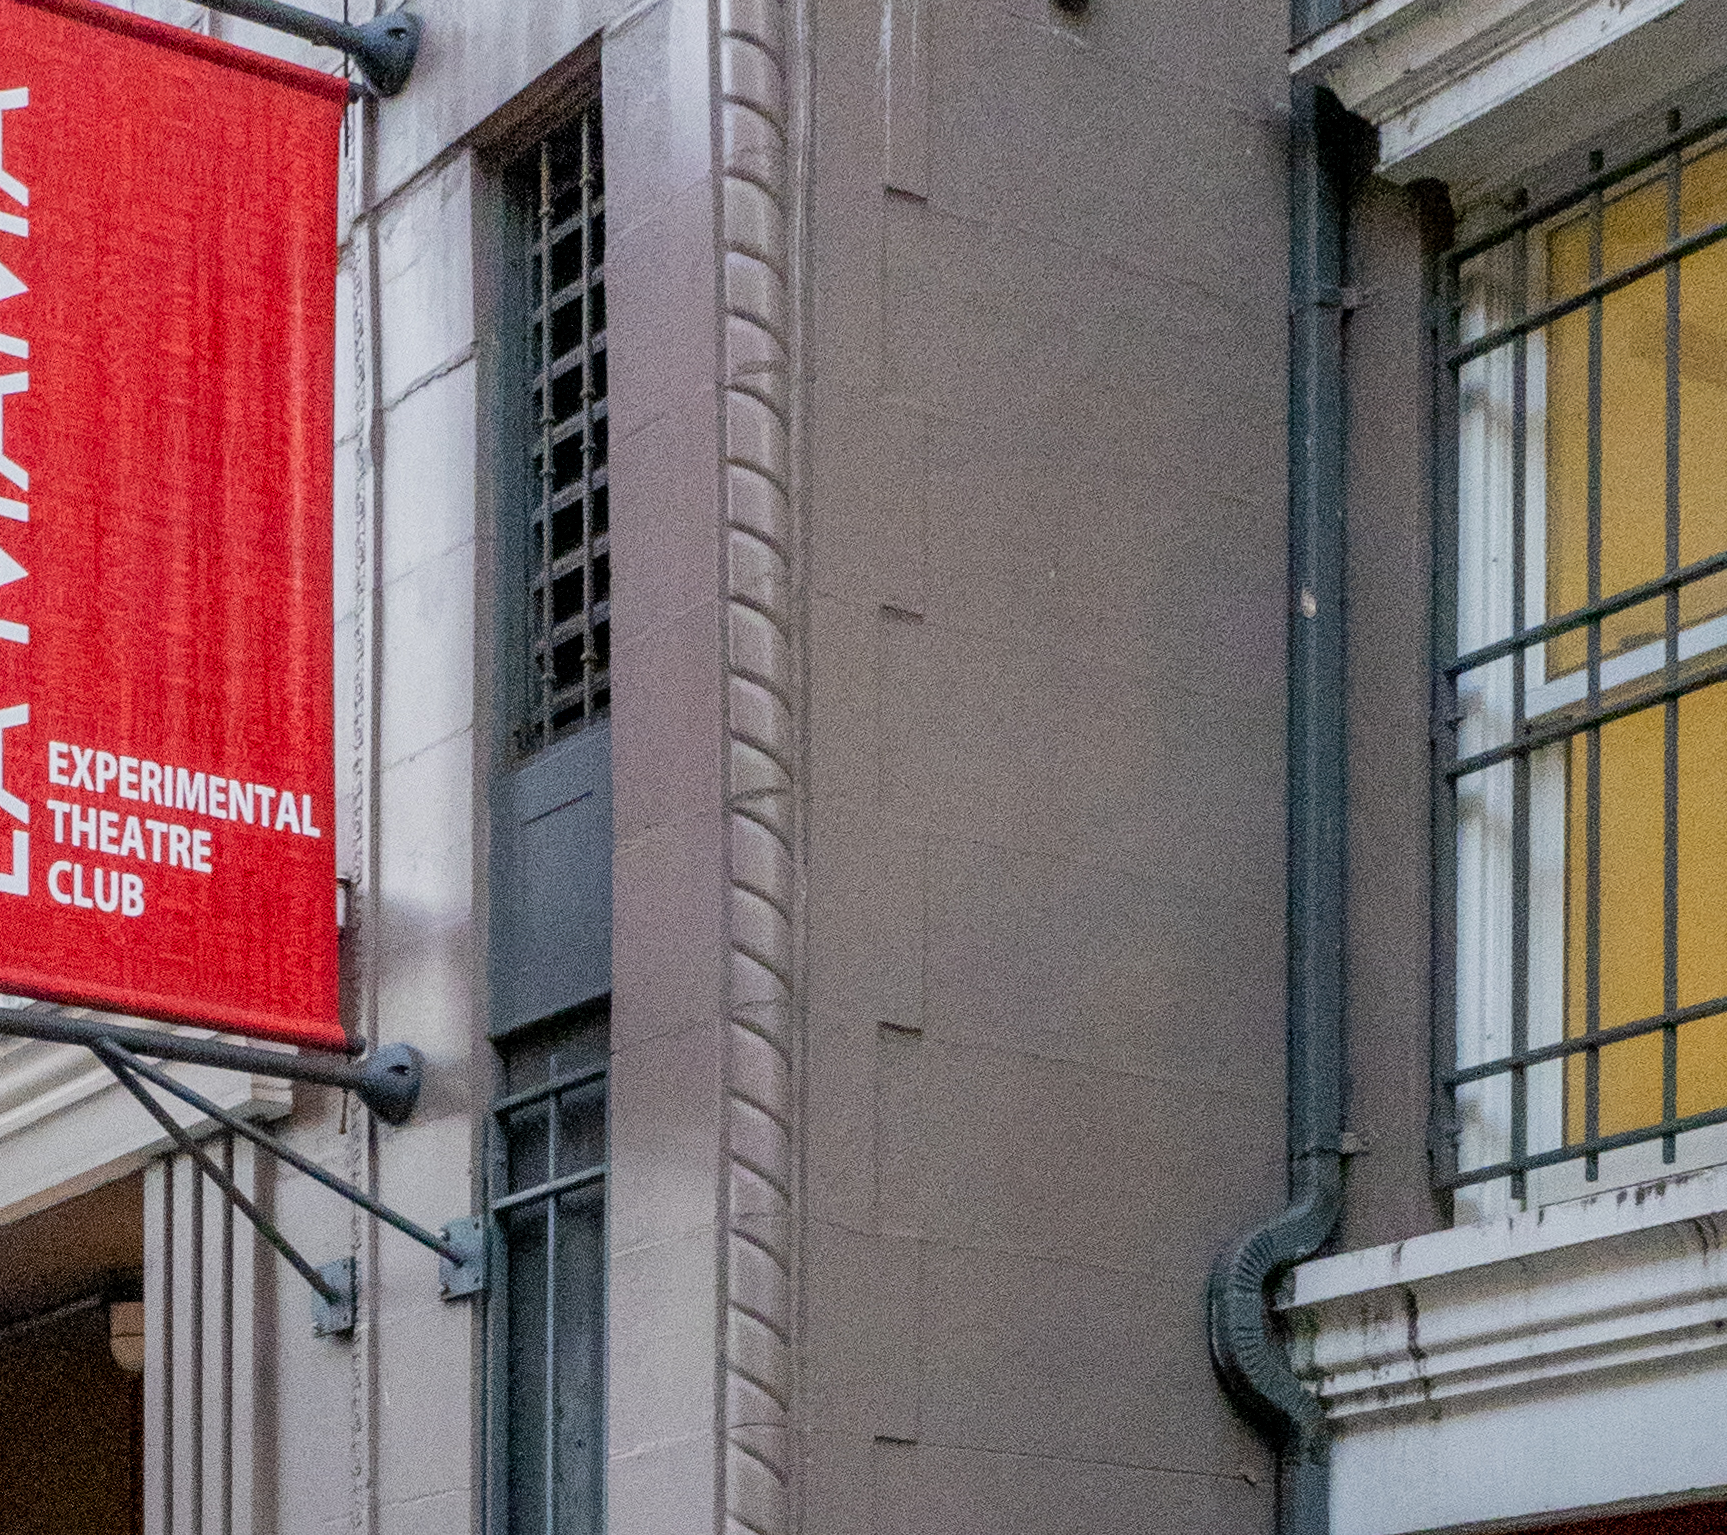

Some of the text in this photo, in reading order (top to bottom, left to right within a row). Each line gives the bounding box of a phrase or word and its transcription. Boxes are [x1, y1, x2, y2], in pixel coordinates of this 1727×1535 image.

[48, 740, 321, 838] EXPERIMENTAL
[46, 799, 212, 874] THEATRE
[47, 860, 145, 918] CLUB
